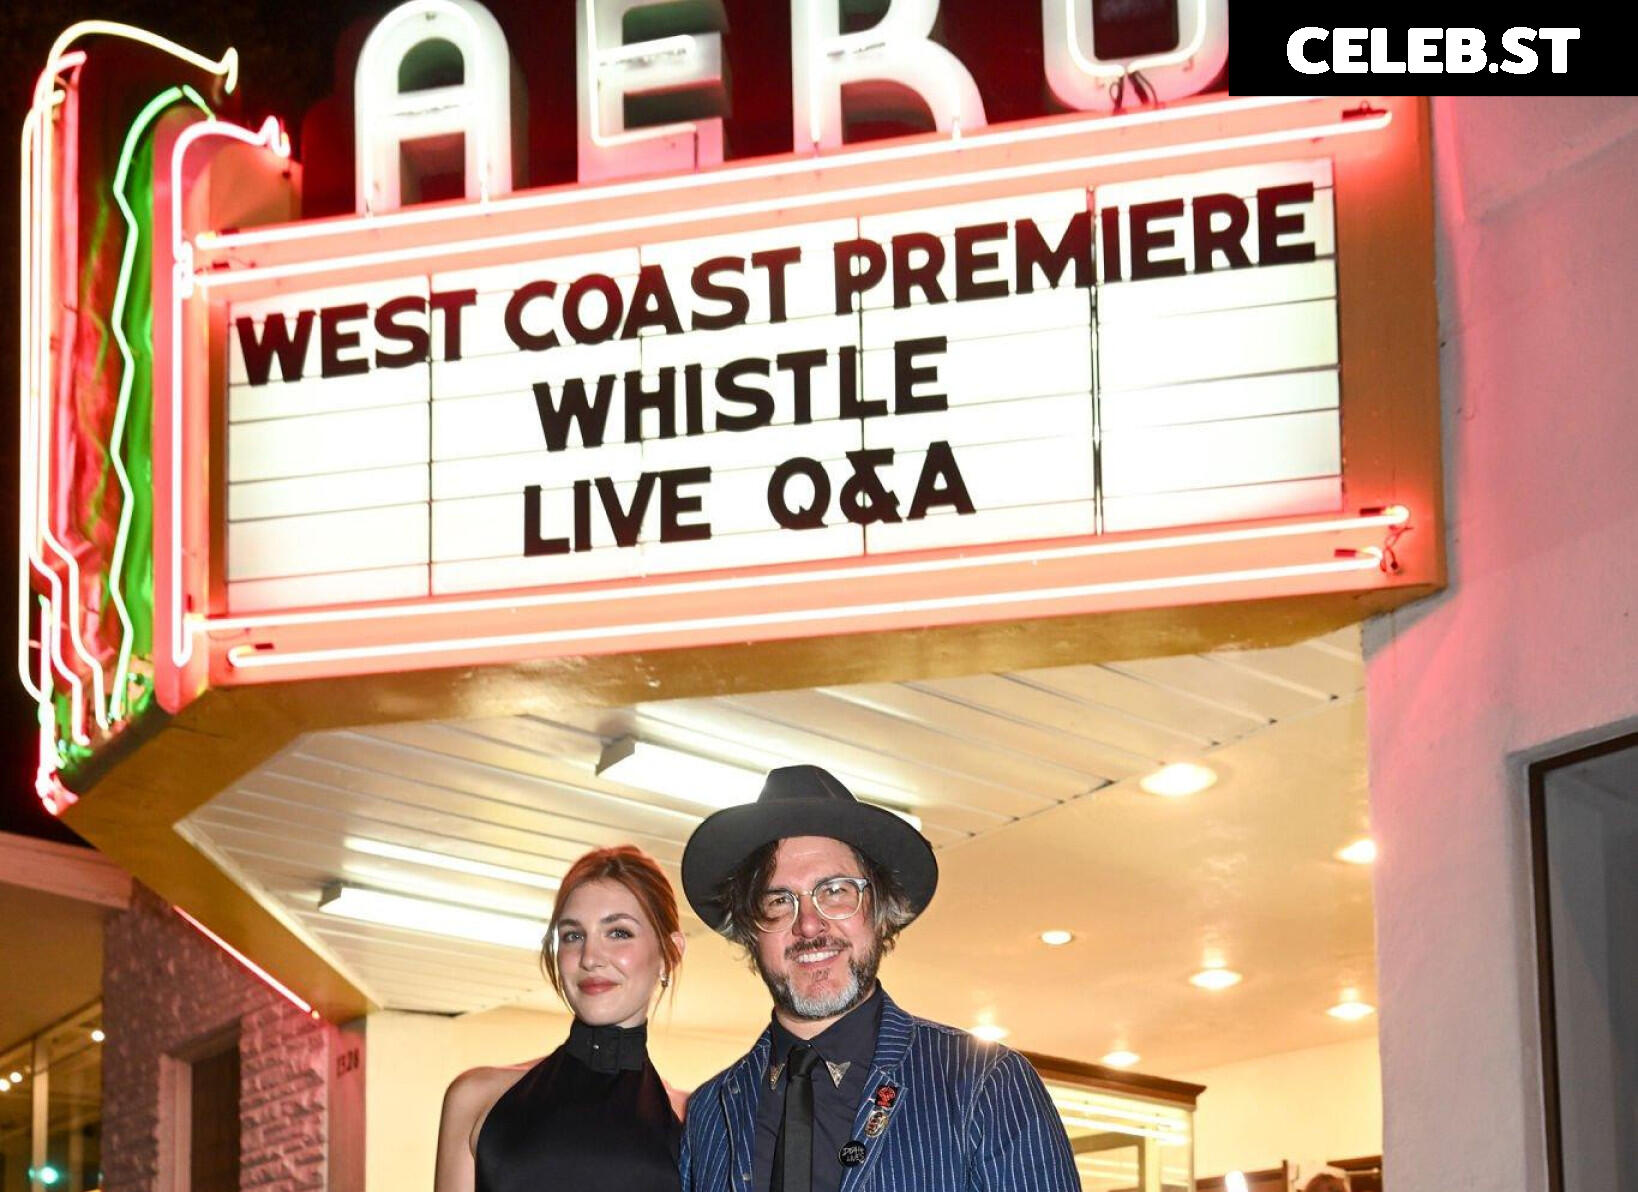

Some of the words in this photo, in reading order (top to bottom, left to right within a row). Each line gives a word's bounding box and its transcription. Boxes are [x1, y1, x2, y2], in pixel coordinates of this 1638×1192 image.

[236, 289, 477, 387] WEST
[504, 246, 802, 352] COAST
[833, 181, 1318, 316] PREMIERE
[532, 335, 949, 452] WHISTLE
[523, 466, 713, 557] LIVE
[766, 440, 977, 531] Q&A
